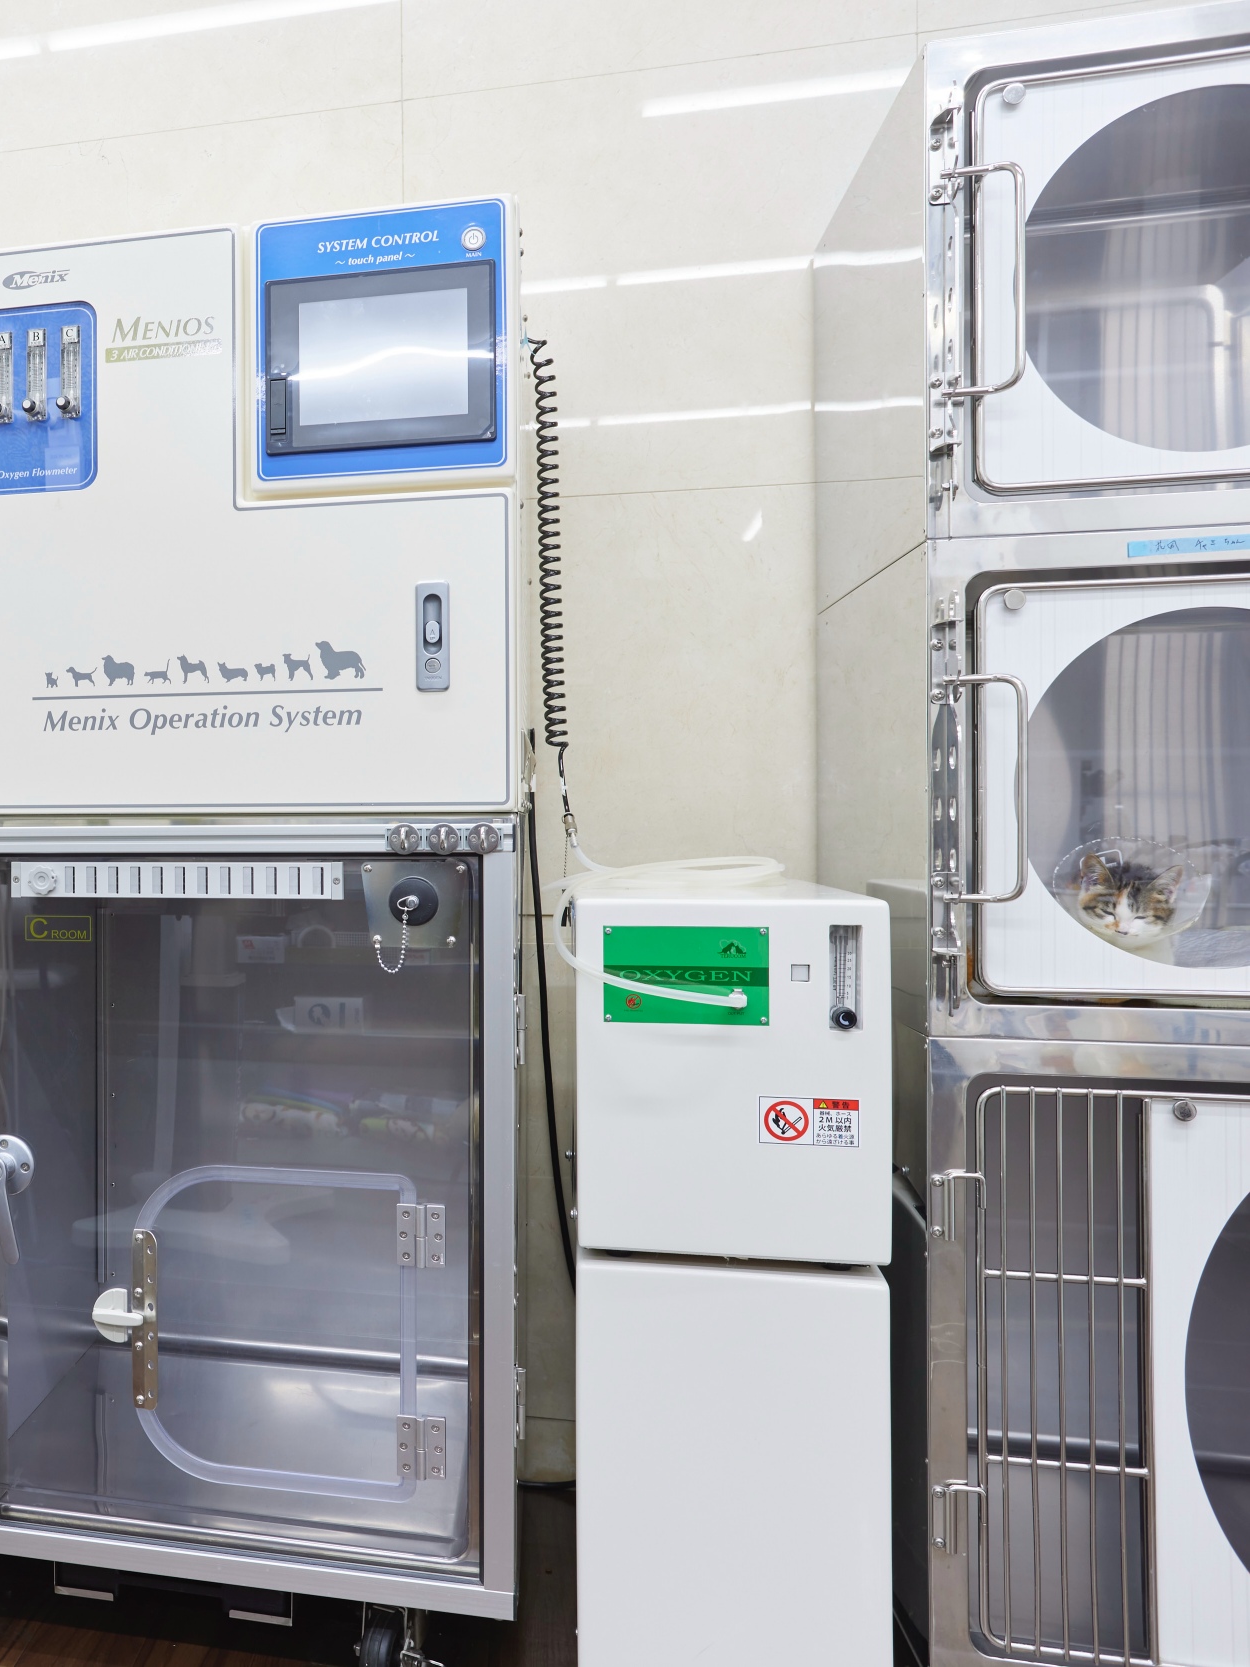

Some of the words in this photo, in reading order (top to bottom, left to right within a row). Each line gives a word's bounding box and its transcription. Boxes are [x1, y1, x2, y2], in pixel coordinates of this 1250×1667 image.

[317, 238, 367, 254] SYSTEM
[371, 230, 440, 248] CONTROL
[348, 253, 374, 265] touch
[376, 251, 403, 264] panel
[9, 269, 71, 289] Menix
[32, 331, 40, 341] B
[65, 328, 74, 338] C
[111, 315, 216, 343] MENIOS
[110, 350, 119, 361] 3
[120, 348, 138, 360] AIR
[32, 466, 78, 477] Flowmeter
[43, 708, 119, 732] Menix
[129, 705, 260, 736] Operation
[269, 704, 363, 733] System
[30, 917, 48, 939] C
[51, 929, 87, 940] ROOM
[619, 969, 753, 982] OXYGEN
